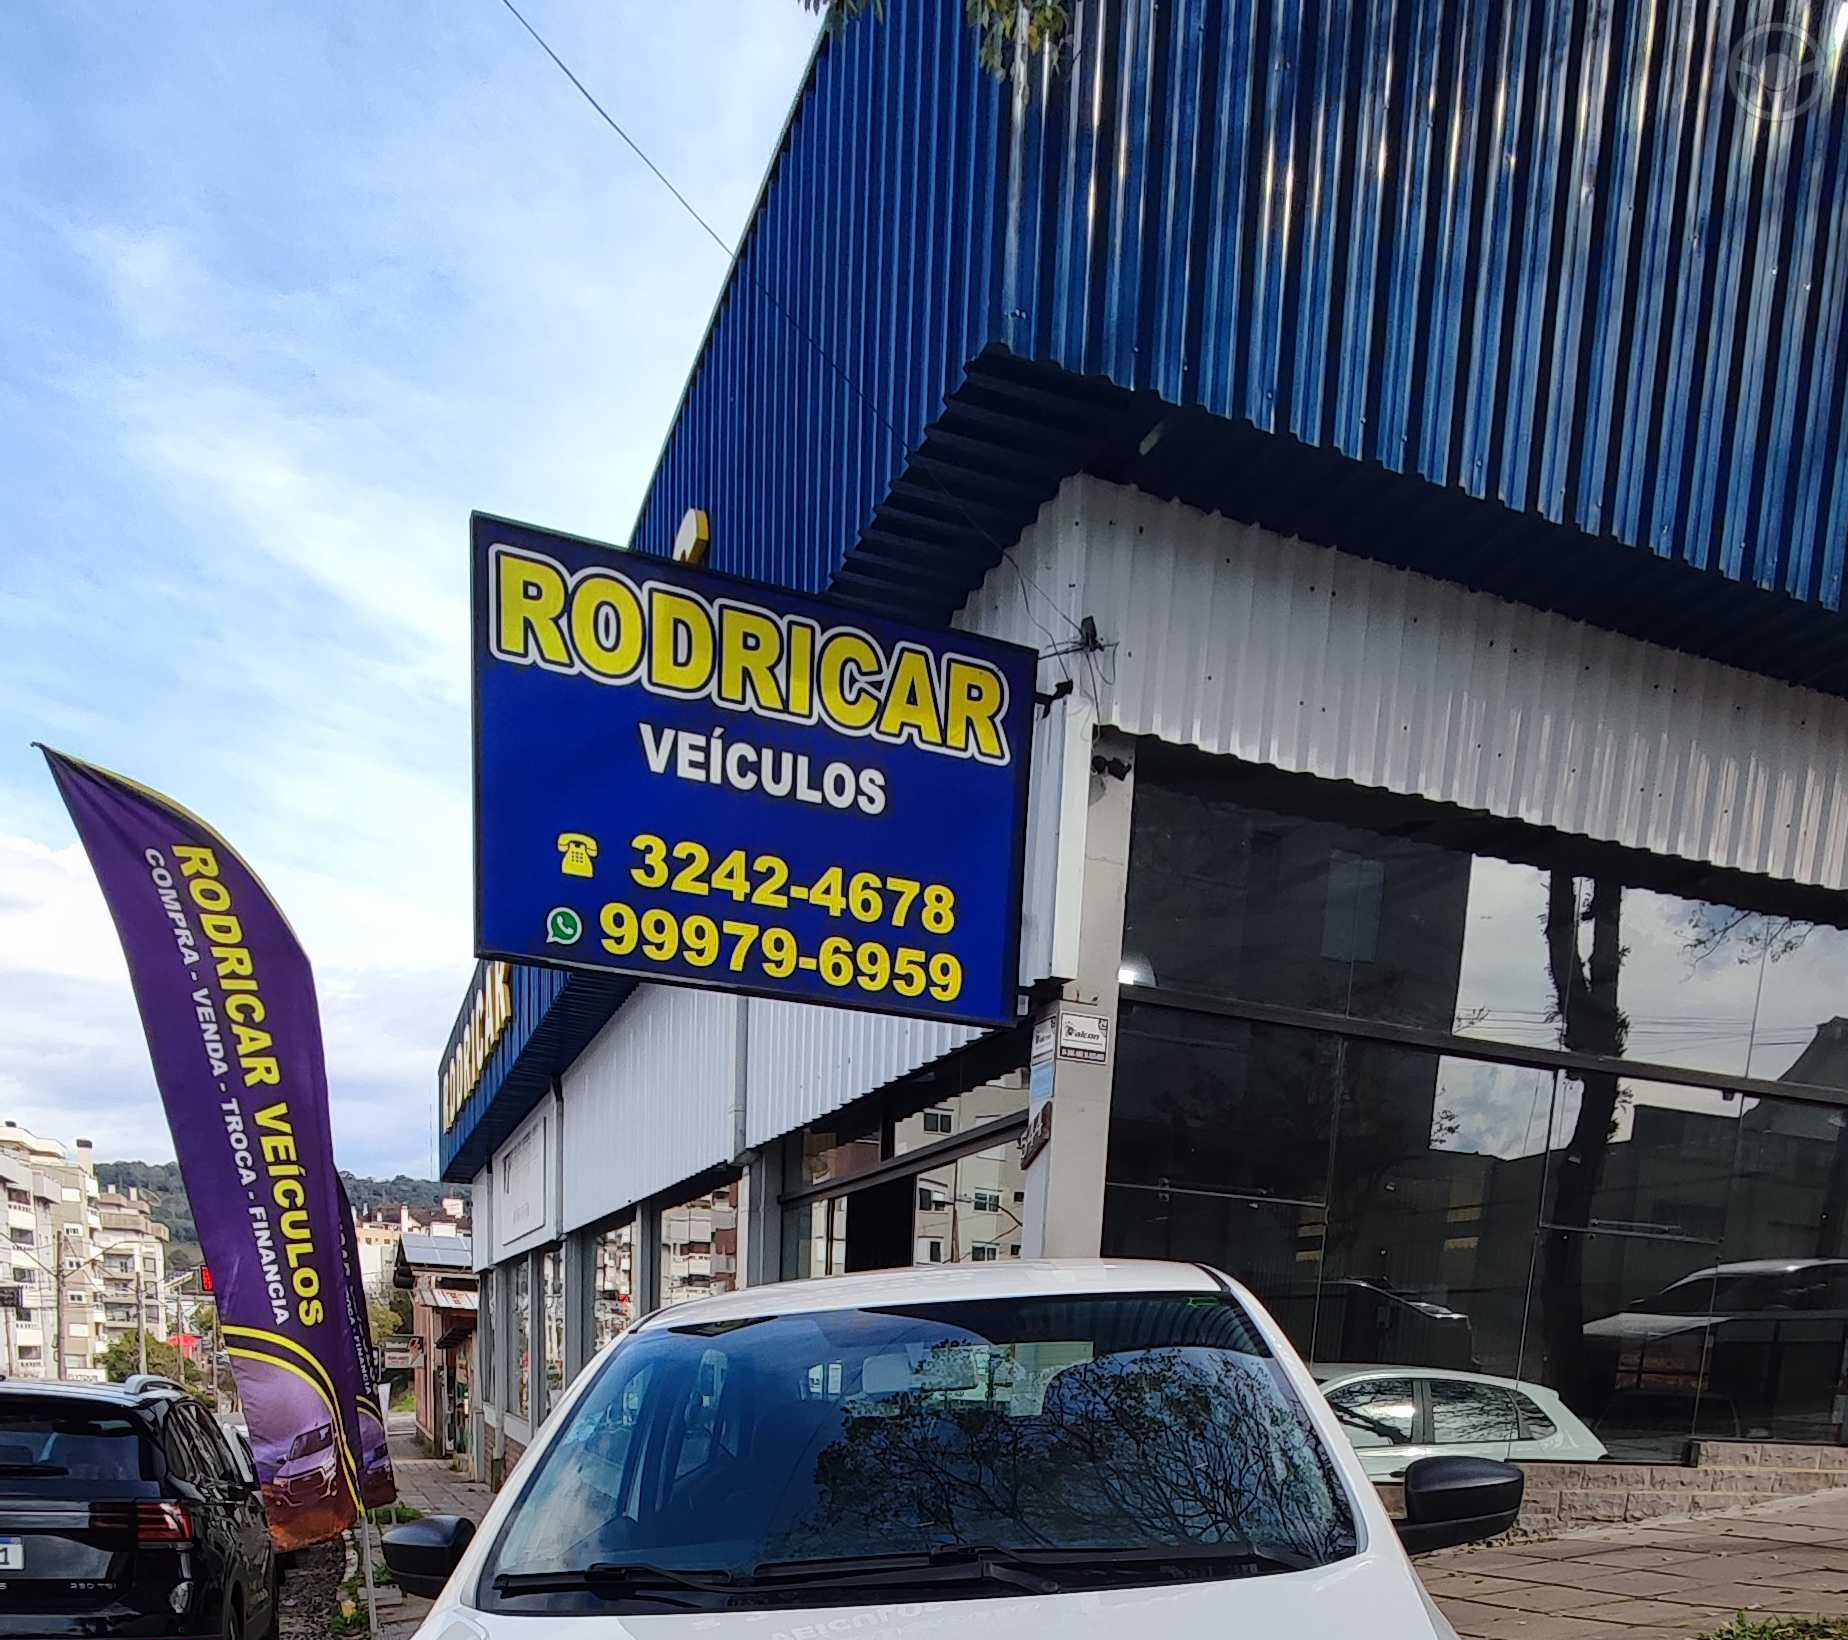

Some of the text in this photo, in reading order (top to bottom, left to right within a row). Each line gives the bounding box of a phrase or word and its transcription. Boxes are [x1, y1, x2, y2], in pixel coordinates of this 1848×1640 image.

[497, 551, 1005, 759] RODRICAR
[639, 723, 886, 815] VEÍCULOS
[600, 901, 963, 1002] 99979-6959
[630, 833, 956, 935] 3242-4678
[145, 847, 201, 966] COMPRA
[191, 987, 229, 1077] VENDA
[220, 1097, 258, 1187] TROCA
[247, 1205, 291, 1326] FINANCIA
[173, 844, 325, 1328] RODRICAR VEÍCULOS
